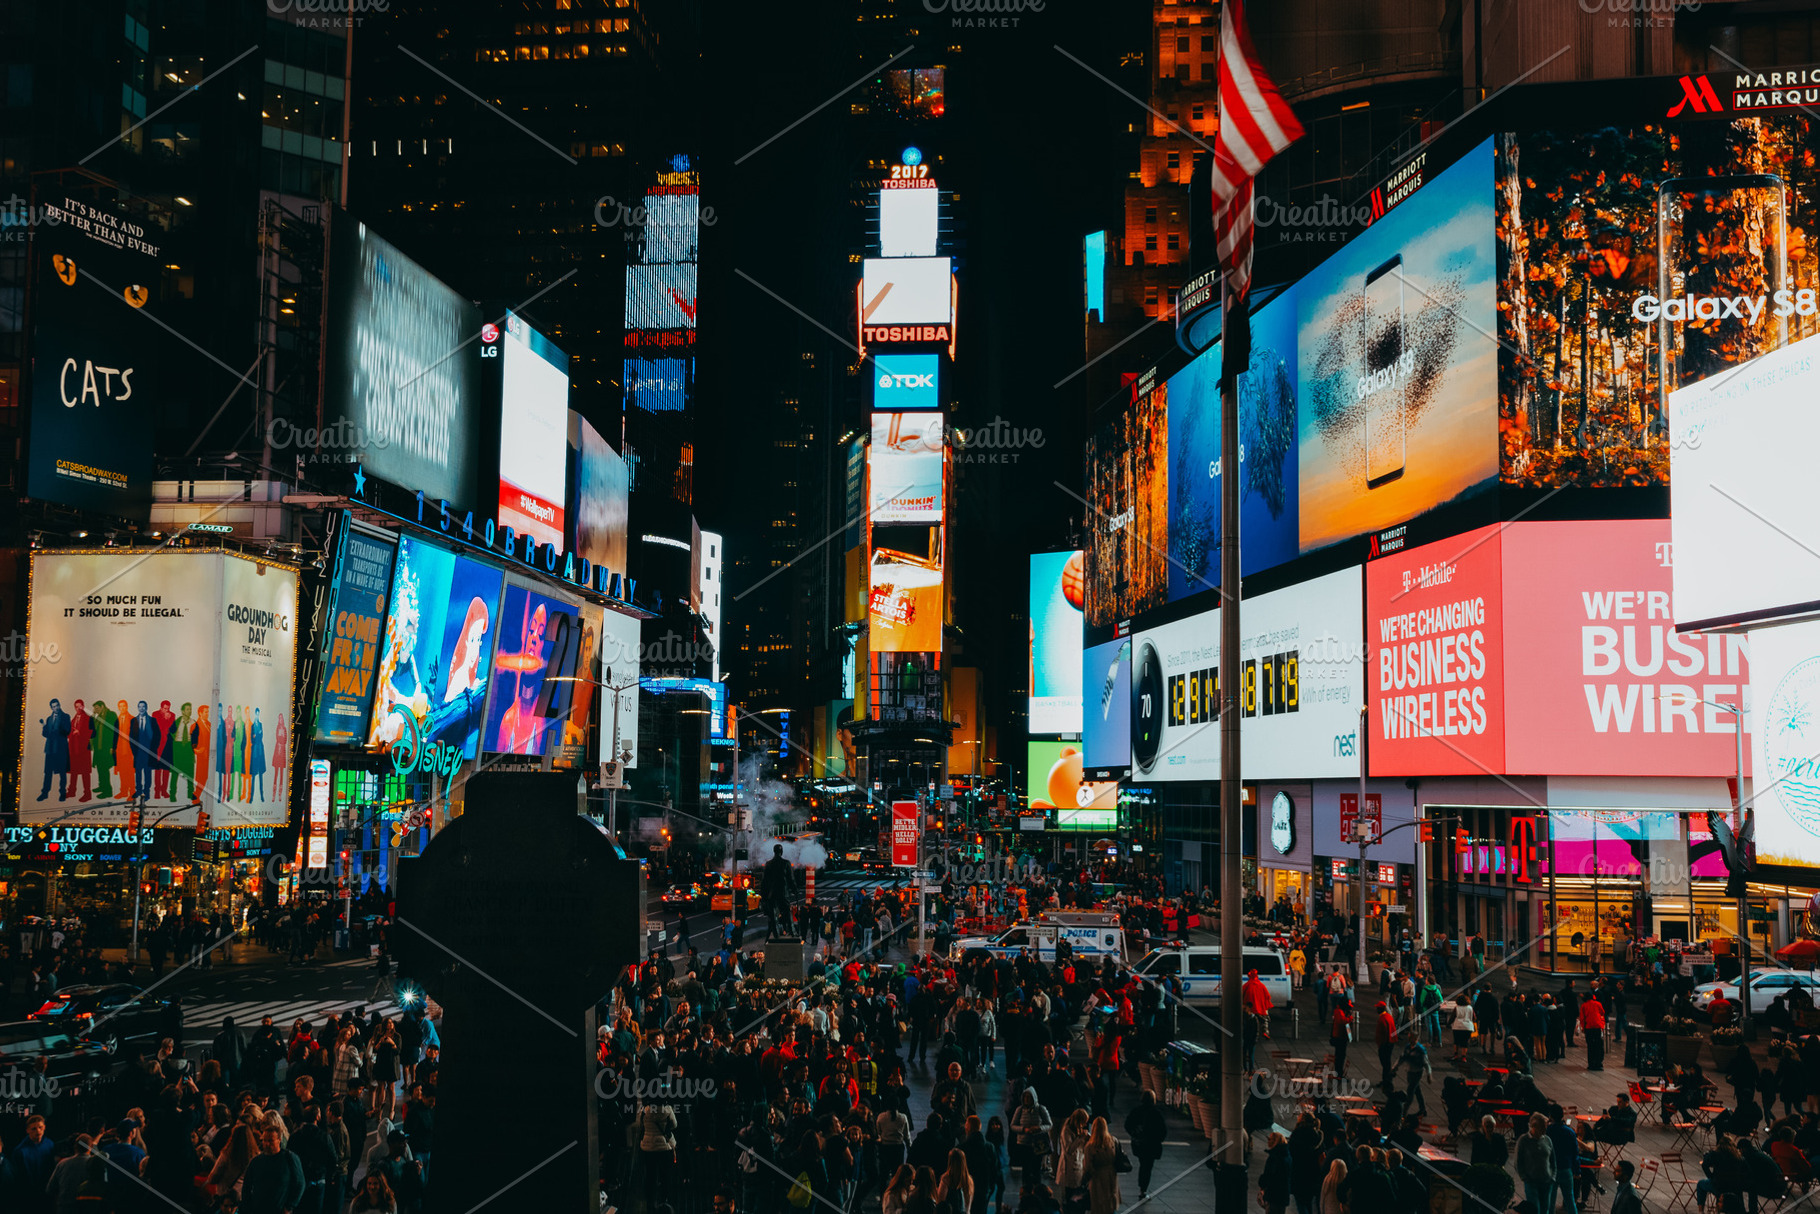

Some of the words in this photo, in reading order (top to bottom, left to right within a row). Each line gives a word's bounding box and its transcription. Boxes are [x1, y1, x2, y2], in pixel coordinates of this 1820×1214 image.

[891, 165, 929, 179] 2017
[1386, 151, 1427, 191] MARRIOTT
[882, 179, 937, 189] TOSHIBA
[1386, 173, 1423, 209] MARQUIS
[65, 197, 87, 216] IT'S
[88, 207, 118, 229] BACK
[120, 221, 144, 238] AND
[93, 222, 125, 245] THAN
[1632, 293, 1767, 326] Galaxy
[1772, 289, 1818, 317] S8
[863, 326, 949, 342] TOSHIBA
[481, 346, 498, 358] LG
[60, 357, 133, 408] CATS
[891, 374, 934, 388] TDK
[1357, 361, 1399, 400] Galaxy
[1399, 348, 1414, 378] S8
[56, 459, 128, 482] CATSBROADWAY.COM
[520, 494, 555, 522] #WallpaperTV
[891, 496, 936, 506] DUNKIN'
[190, 524, 230, 532] LAMAR
[1381, 526, 1407, 542] MARRIOTT
[416, 490, 495, 549] 1540
[503, 525, 637, 603] BROADWAY
[1381, 538, 1404, 553] MARQUIS
[87, 595, 102, 605] SO
[106, 595, 137, 605] MUCH
[141, 595, 162, 605] FUN
[870, 601, 907, 619] ARTOIS
[873, 593, 907, 611] STELLA
[1582, 590, 1673, 620] WE'R
[64, 608, 75, 618] IT
[79, 608, 119, 618] SHOULD
[123, 608, 137, 618] BE
[227, 603, 289, 632] GROUNDHOG
[1380, 612, 1416, 643] WE'RE
[1417, 597, 1485, 637] CHANGING
[248, 626, 267, 646] DAY
[336, 611, 380, 643] COME
[242, 645, 250, 655] THE
[251, 648, 272, 658] MUSICAL
[331, 637, 376, 670] FROM
[1380, 630, 1486, 692] BUSINESS
[326, 665, 372, 697] AWAY
[1325, 682, 1350, 704] energy
[1141, 693, 1152, 718] 70
[1381, 686, 1487, 739] WIRELESS
[1334, 729, 1356, 757] nest
[51, 827, 154, 844] LUGGAGE
[236, 827, 275, 840] LUGGAGE
[59, 843, 78, 852] NY
[1067, 929, 1097, 938] POLICE
